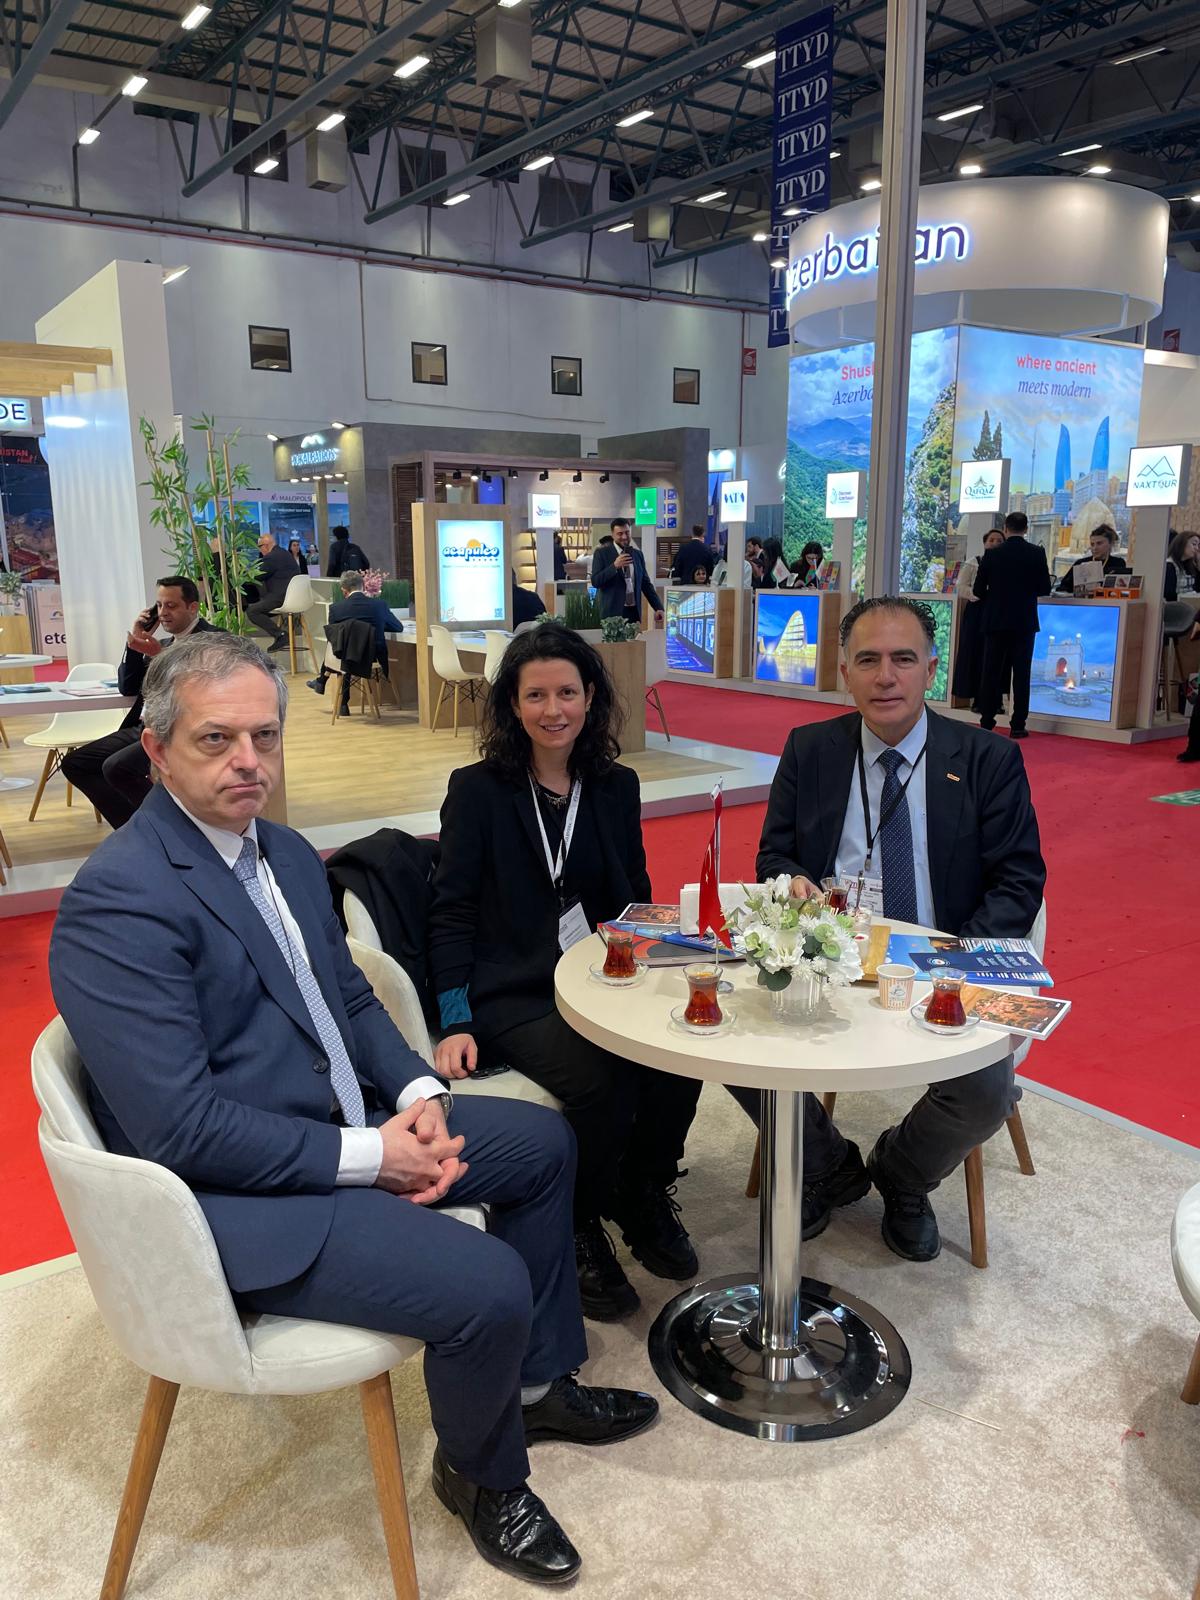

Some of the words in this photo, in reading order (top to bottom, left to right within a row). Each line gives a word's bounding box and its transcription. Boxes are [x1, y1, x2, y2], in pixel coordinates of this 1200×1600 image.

[778, 32, 829, 73] TTYD
[778, 77, 828, 117] TTYD
[777, 123, 826, 161] TTYD
[776, 169, 825, 205] TTYD
[787, 226, 965, 296] zerbaian
[1016, 353, 1052, 370] where
[1055, 358, 1096, 375] ancient
[1018, 380, 1050, 395] meets
[1051, 380, 1092, 398] modern
[1133, 479, 1178, 489] NAXTOUR
[442, 543, 500, 562] acapulco
